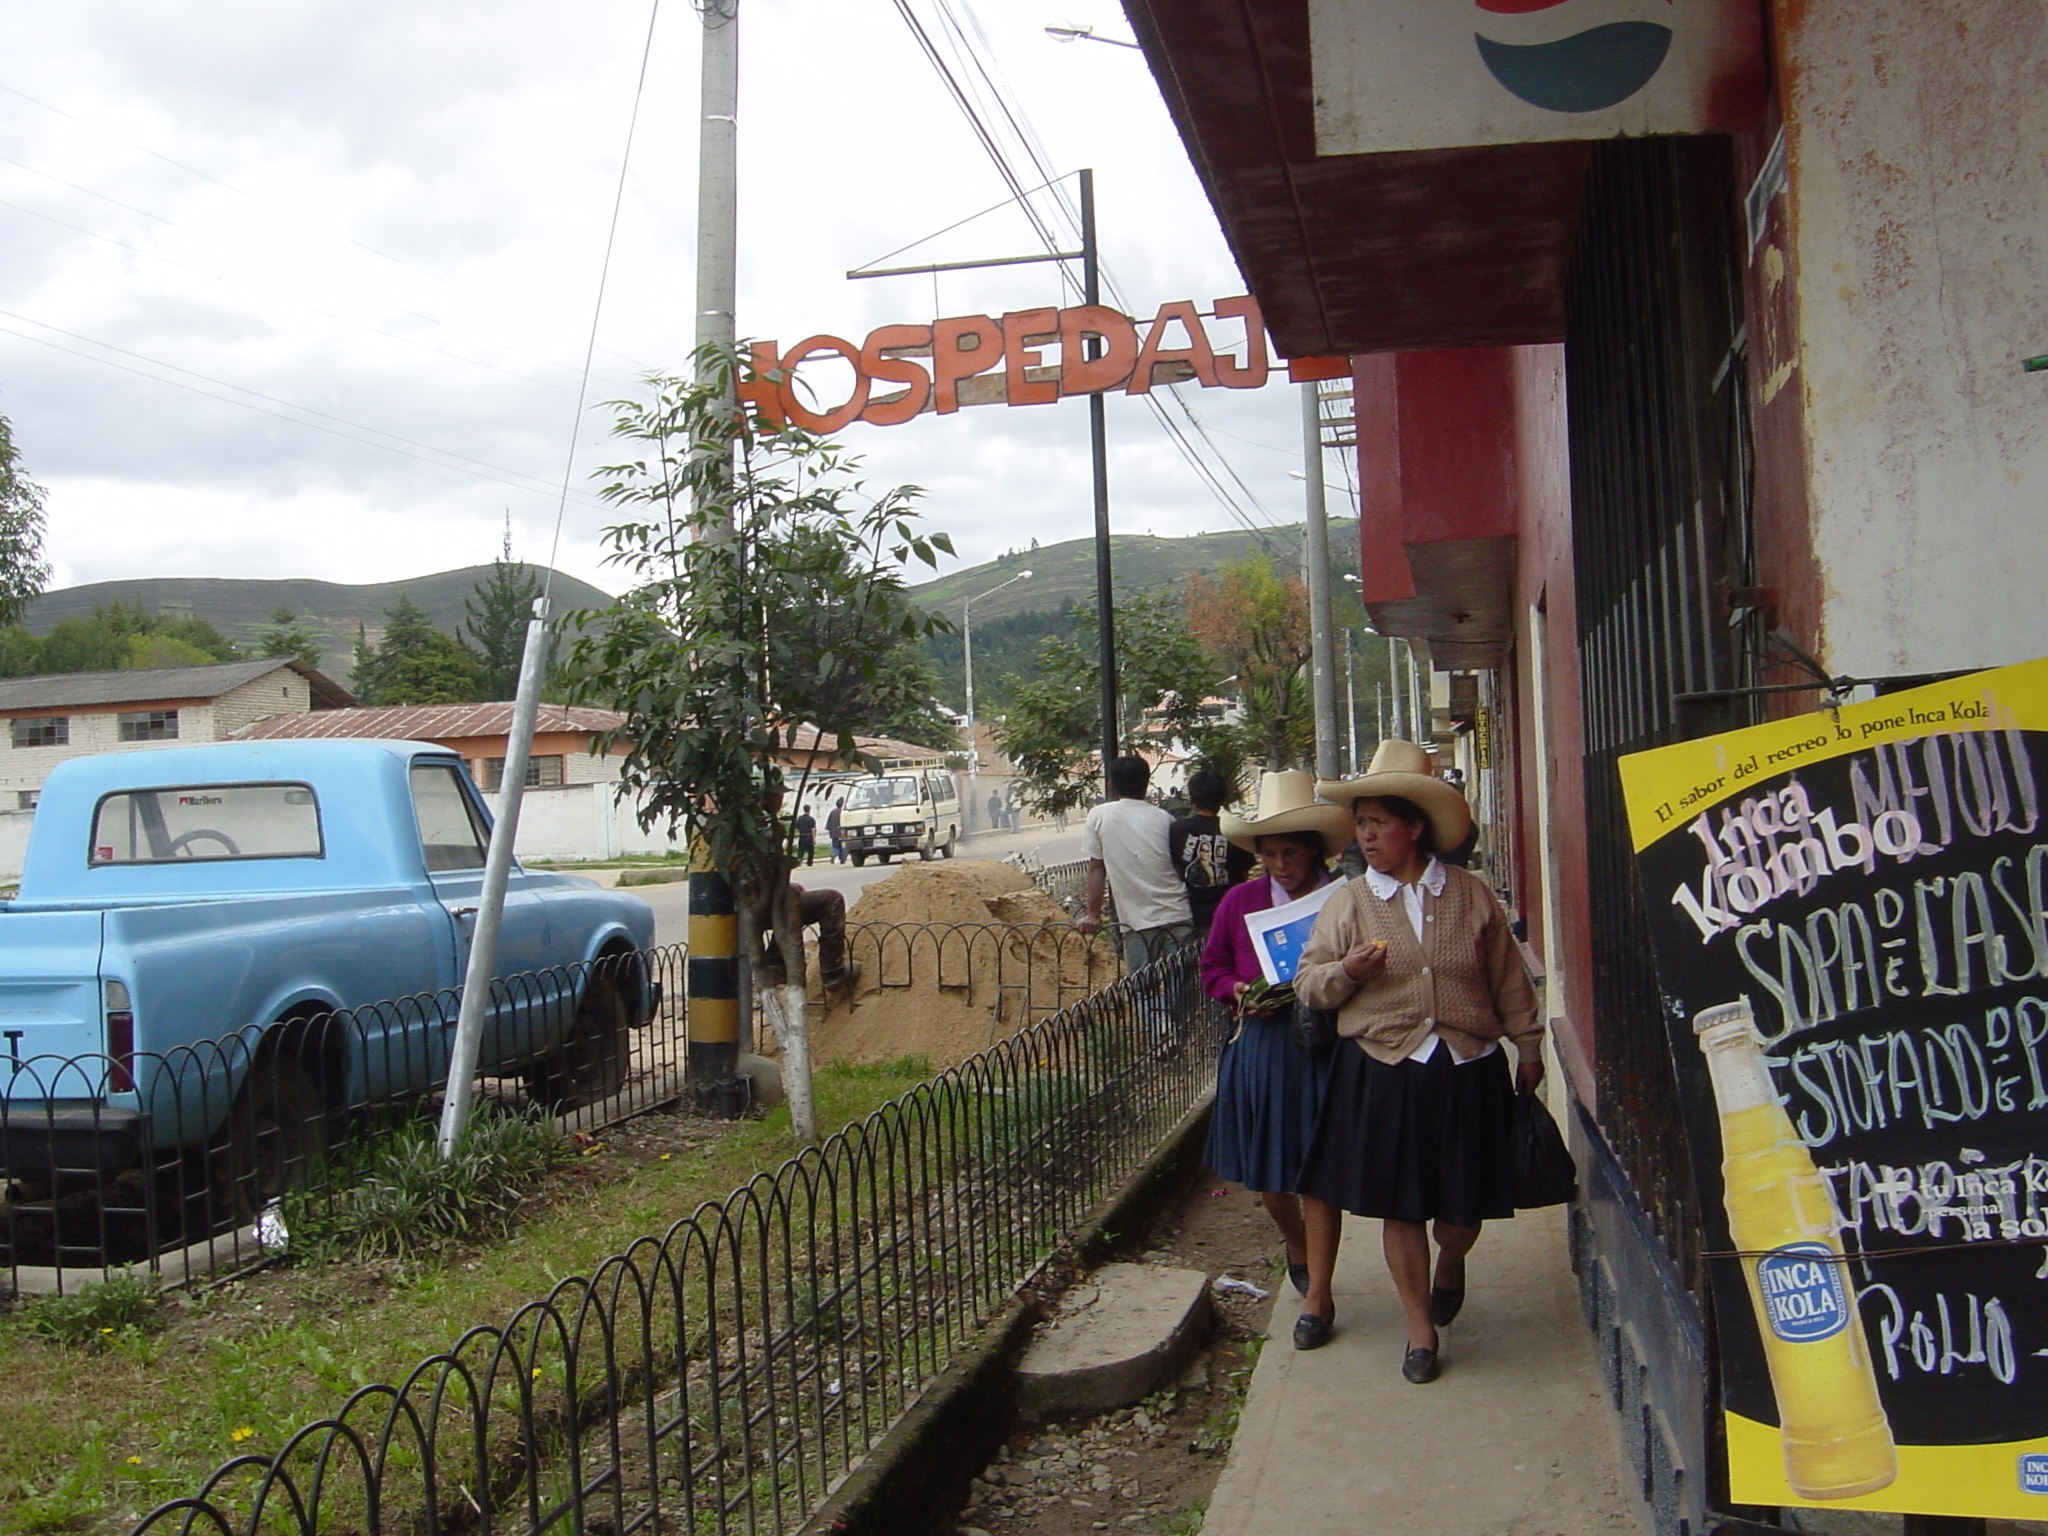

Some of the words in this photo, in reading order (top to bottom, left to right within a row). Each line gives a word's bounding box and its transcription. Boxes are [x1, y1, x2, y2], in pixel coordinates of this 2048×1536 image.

[722, 295, 1352, 436] HOSPEDAJ
[1654, 804, 1674, 823] El
[1679, 777, 1725, 810] sabor
[1733, 755, 1760, 779] del
[1766, 736, 1828, 765] recreo
[1834, 724, 1852, 744] lo
[1860, 713, 1906, 739] pone
[1907, 707, 1946, 725] Inca
[1949, 700, 1990, 720] Kola
[1687, 780, 1815, 868] Inca
[1671, 806, 1921, 945] Kombo
[1918, 1177, 1950, 1199] tu
[1954, 1171, 2017, 1198] Inca
[1973, 1220, 1992, 1239] a
[1766, 1262, 1827, 1294] INCA
[1774, 1287, 1837, 1322] KOLA
